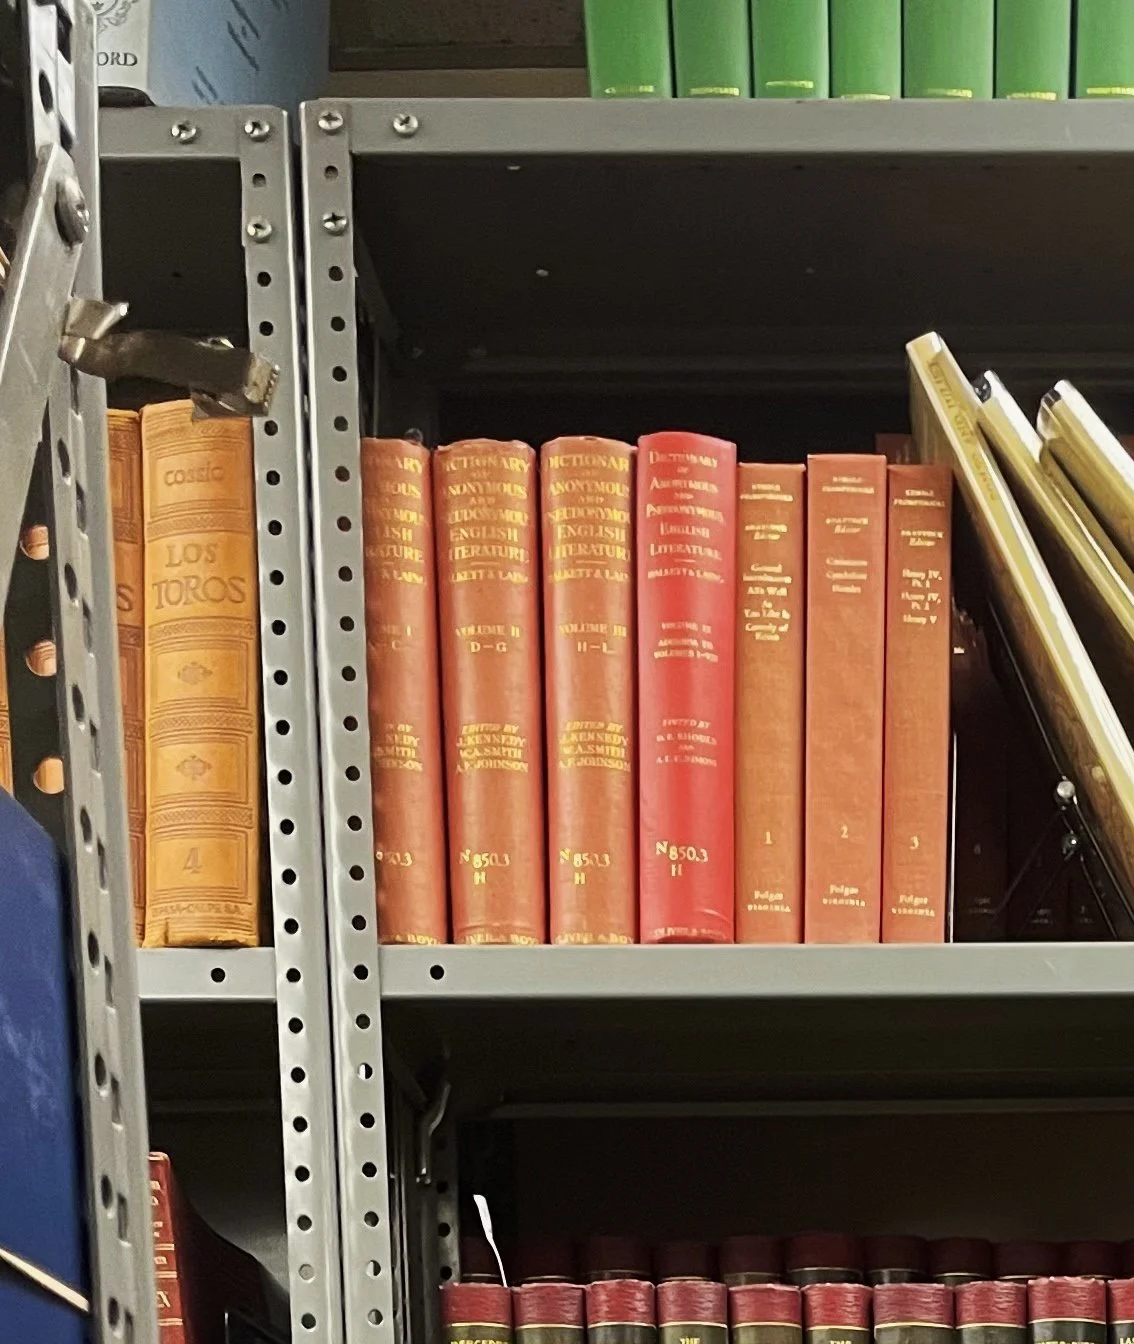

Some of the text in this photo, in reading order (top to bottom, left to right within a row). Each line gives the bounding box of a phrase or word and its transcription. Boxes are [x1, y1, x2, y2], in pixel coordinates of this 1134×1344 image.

[557, 525, 626, 541] ENGLISH
[660, 522, 710, 539] ENGLISH
[165, 543, 218, 568] LOS
[152, 575, 245, 610] TOROS
[765, 831, 772, 844] 1
[840, 825, 849, 839] 2
[910, 835, 920, 850] 3
[181, 846, 203, 875] 4
[669, 846, 709, 863] 850.3
